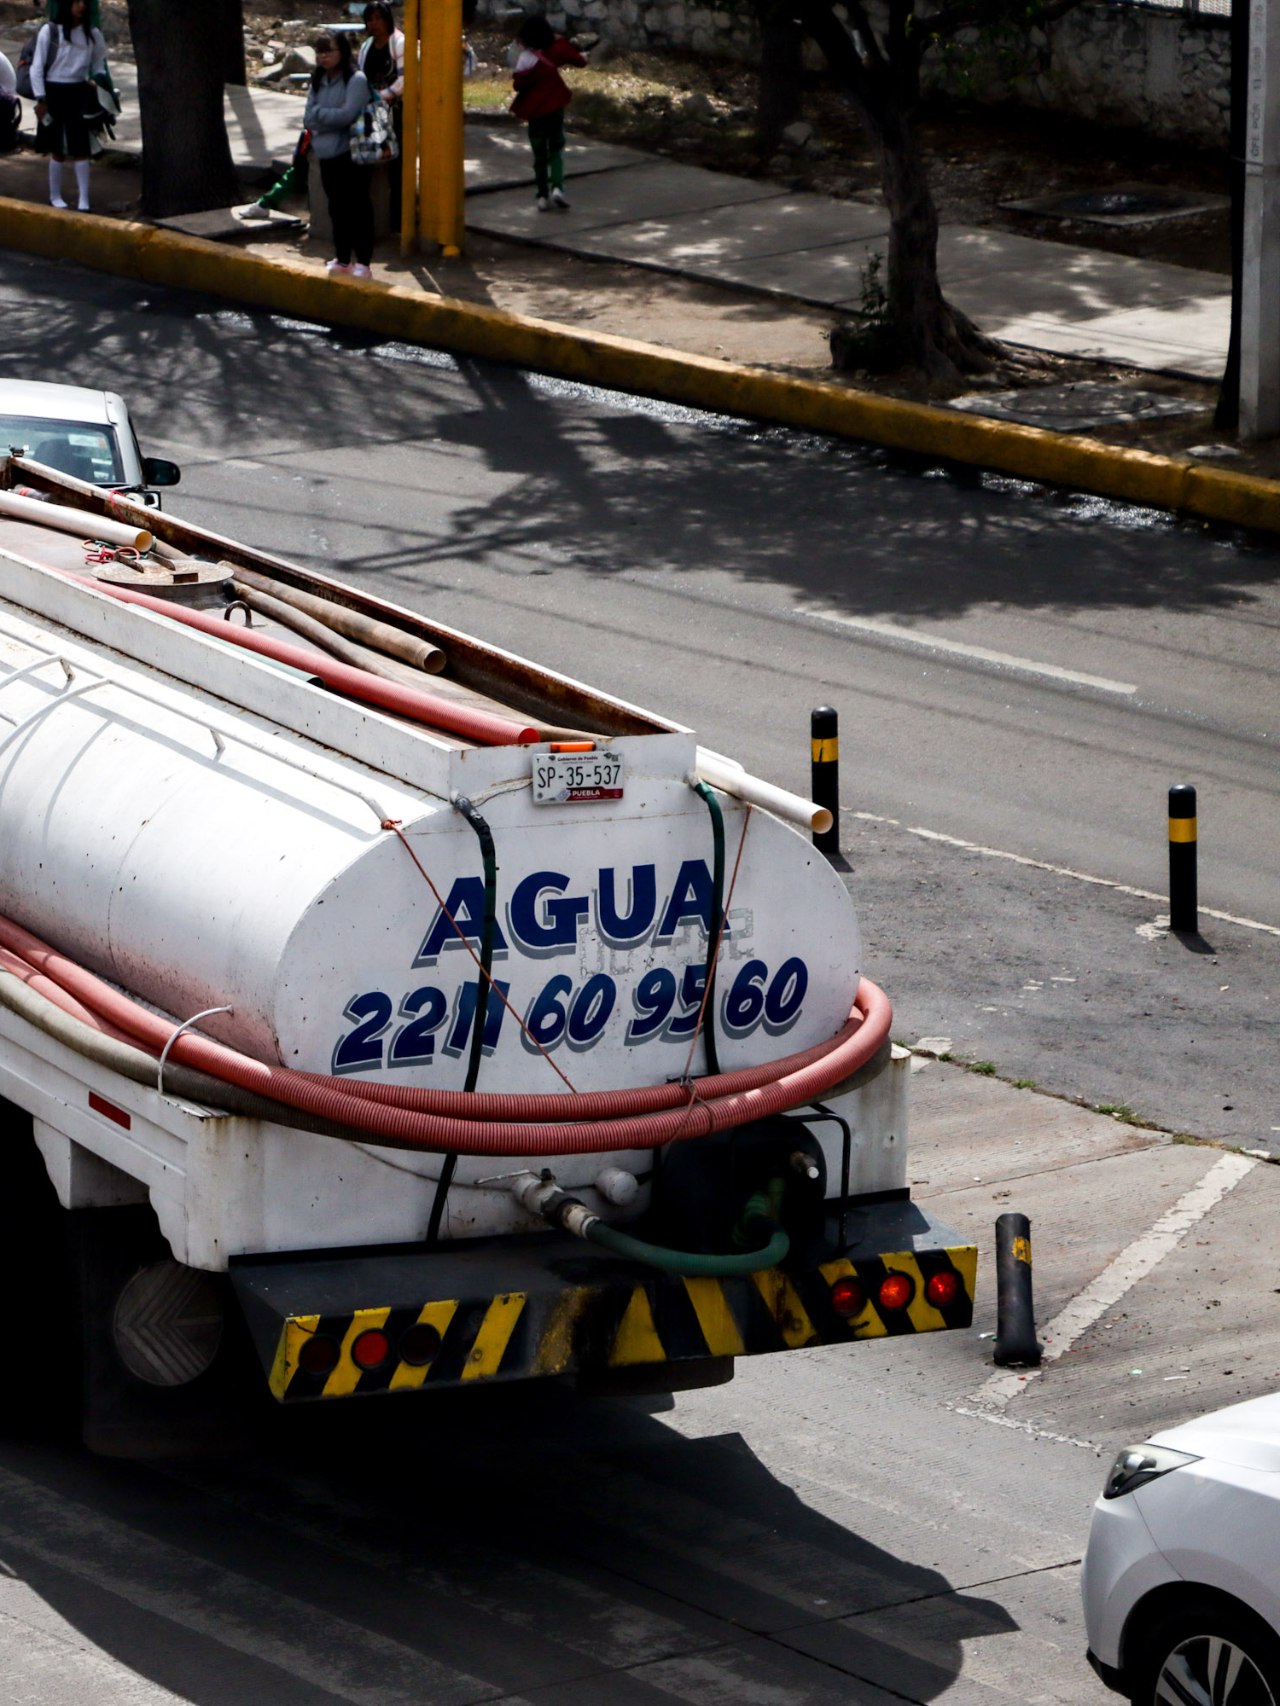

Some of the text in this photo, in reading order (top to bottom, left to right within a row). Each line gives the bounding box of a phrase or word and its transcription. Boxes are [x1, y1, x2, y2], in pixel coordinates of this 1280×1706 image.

[537, 764, 621, 789] SP-35-537
[572, 789, 601, 797] PUEBLA
[411, 858, 731, 969] AGUA
[332, 980, 510, 1075] 2211
[520, 973, 617, 1055] 60
